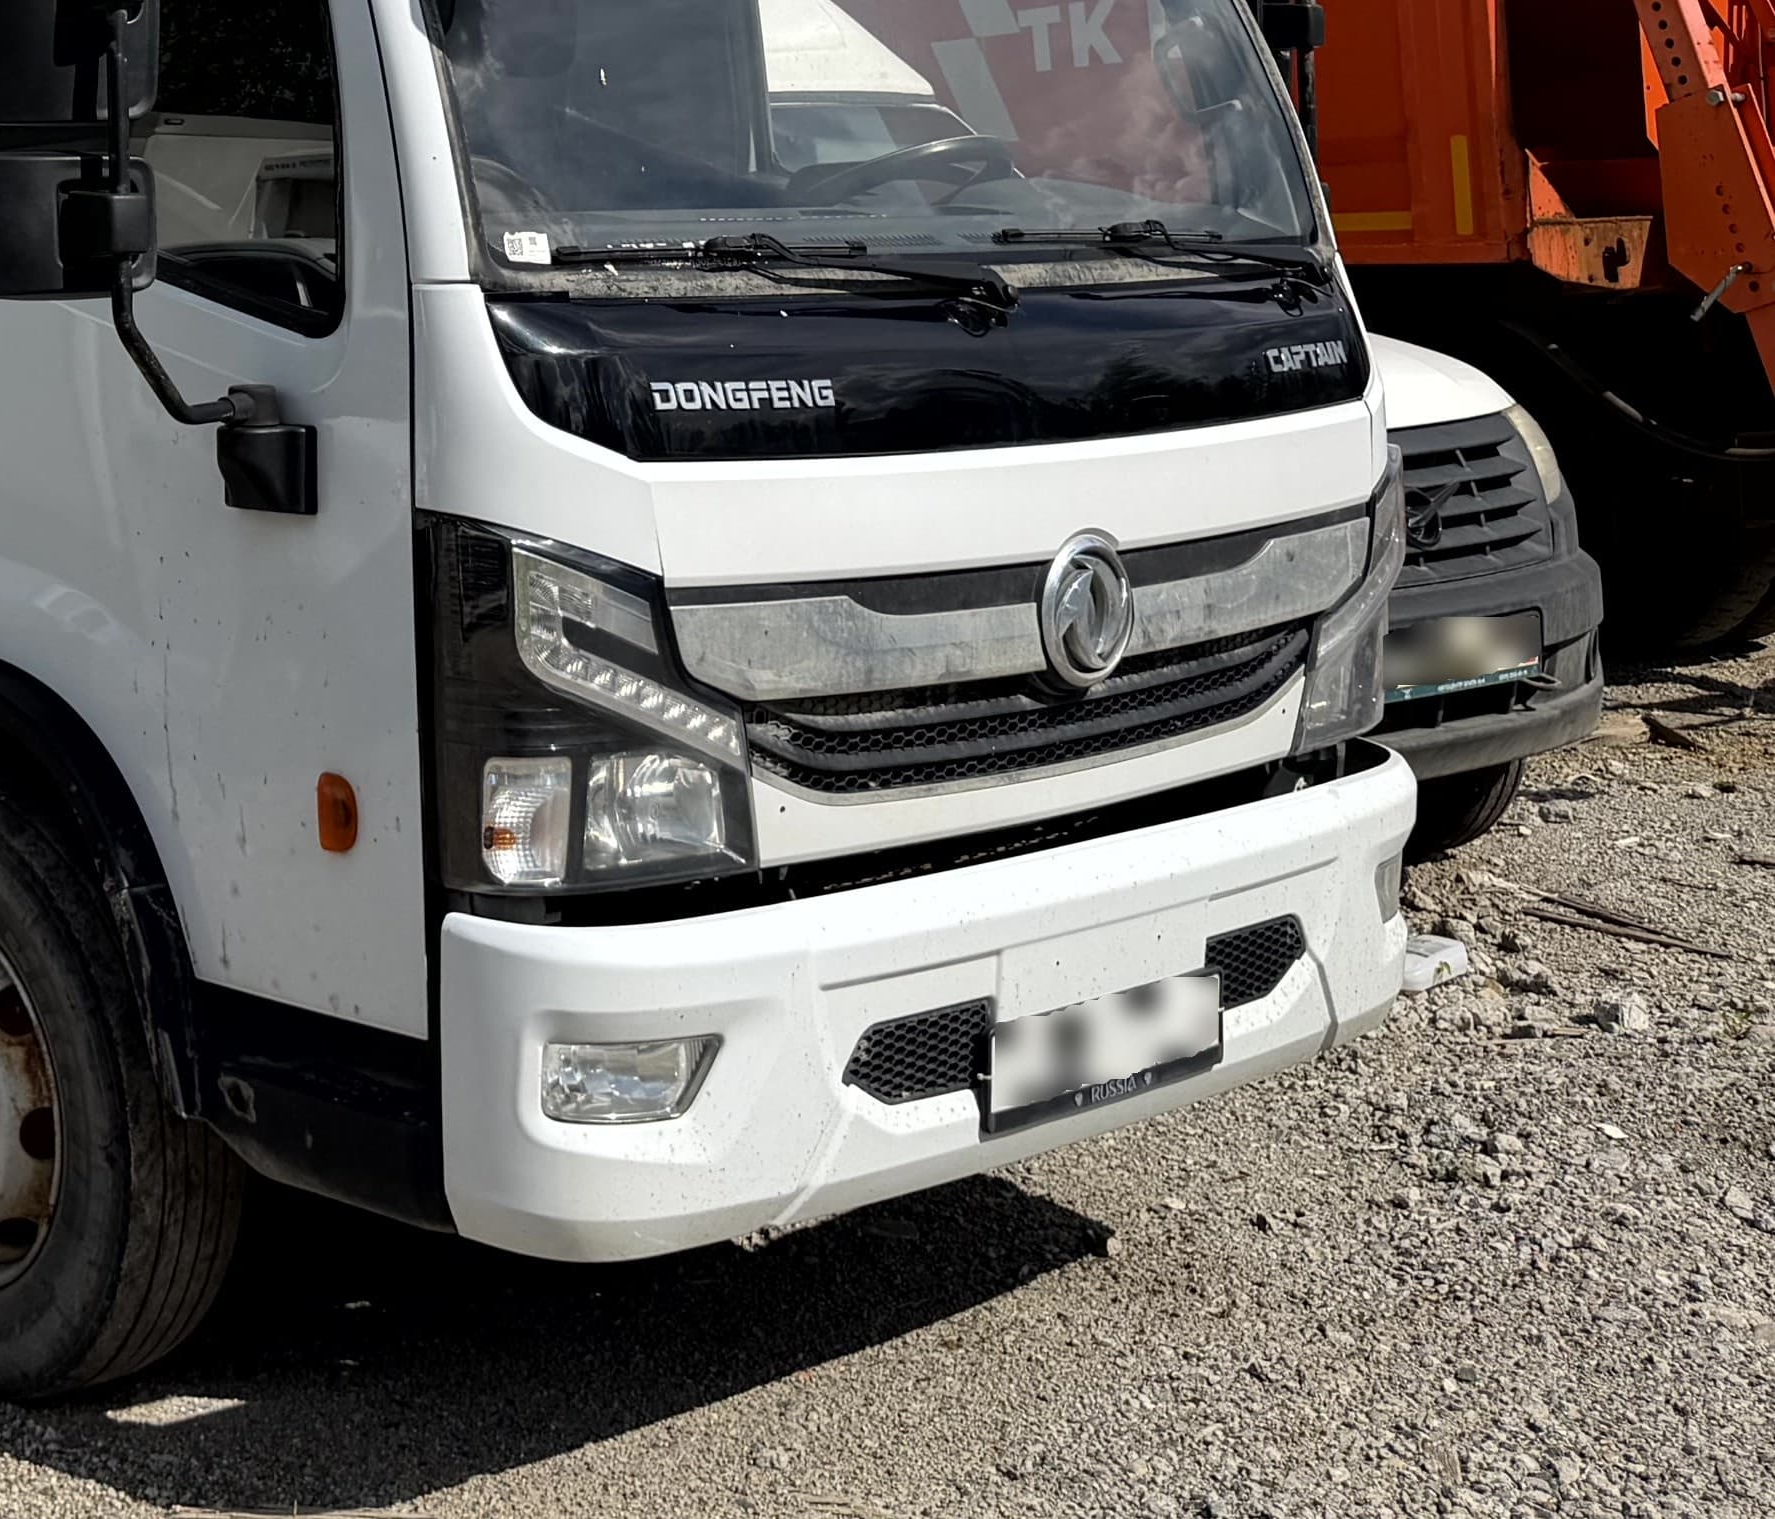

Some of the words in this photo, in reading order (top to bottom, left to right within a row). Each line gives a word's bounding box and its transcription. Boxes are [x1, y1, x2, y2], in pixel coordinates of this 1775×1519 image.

[1266, 340, 1348, 373] CAPTAIN
[649, 379, 836, 410] DONGFENG
[1091, 1076, 1137, 1103] RUSSIA
